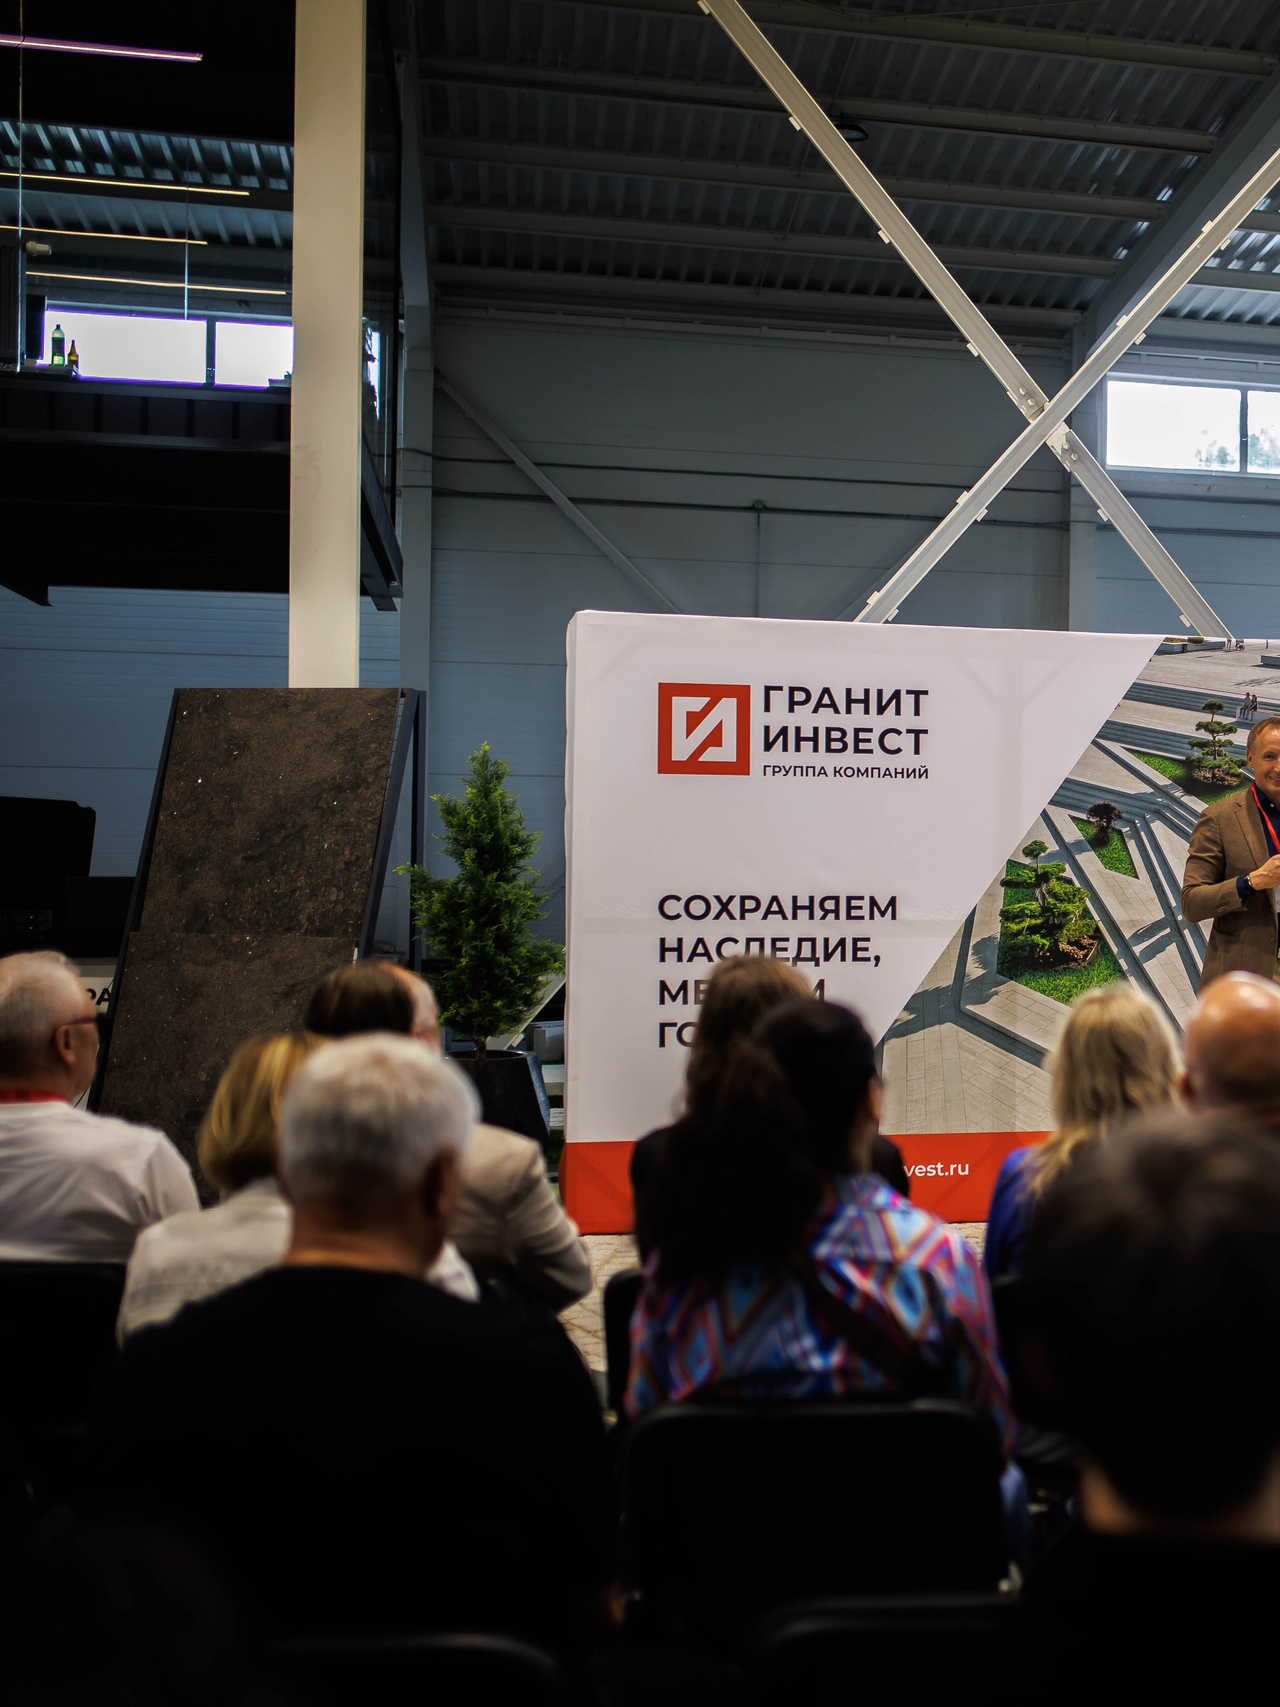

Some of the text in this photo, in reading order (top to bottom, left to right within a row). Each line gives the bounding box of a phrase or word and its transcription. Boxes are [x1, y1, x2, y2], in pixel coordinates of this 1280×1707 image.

[763, 685, 929, 717] ГРАНИТ
[763, 725, 929, 756] ИНВЕСТ
[763, 764, 929, 780] ГРУППА КОМПАНИЙ
[658, 894, 898, 922] СОХРАНЯЕМ
[658, 936, 881, 968] НАСЛЕДИЕ,
